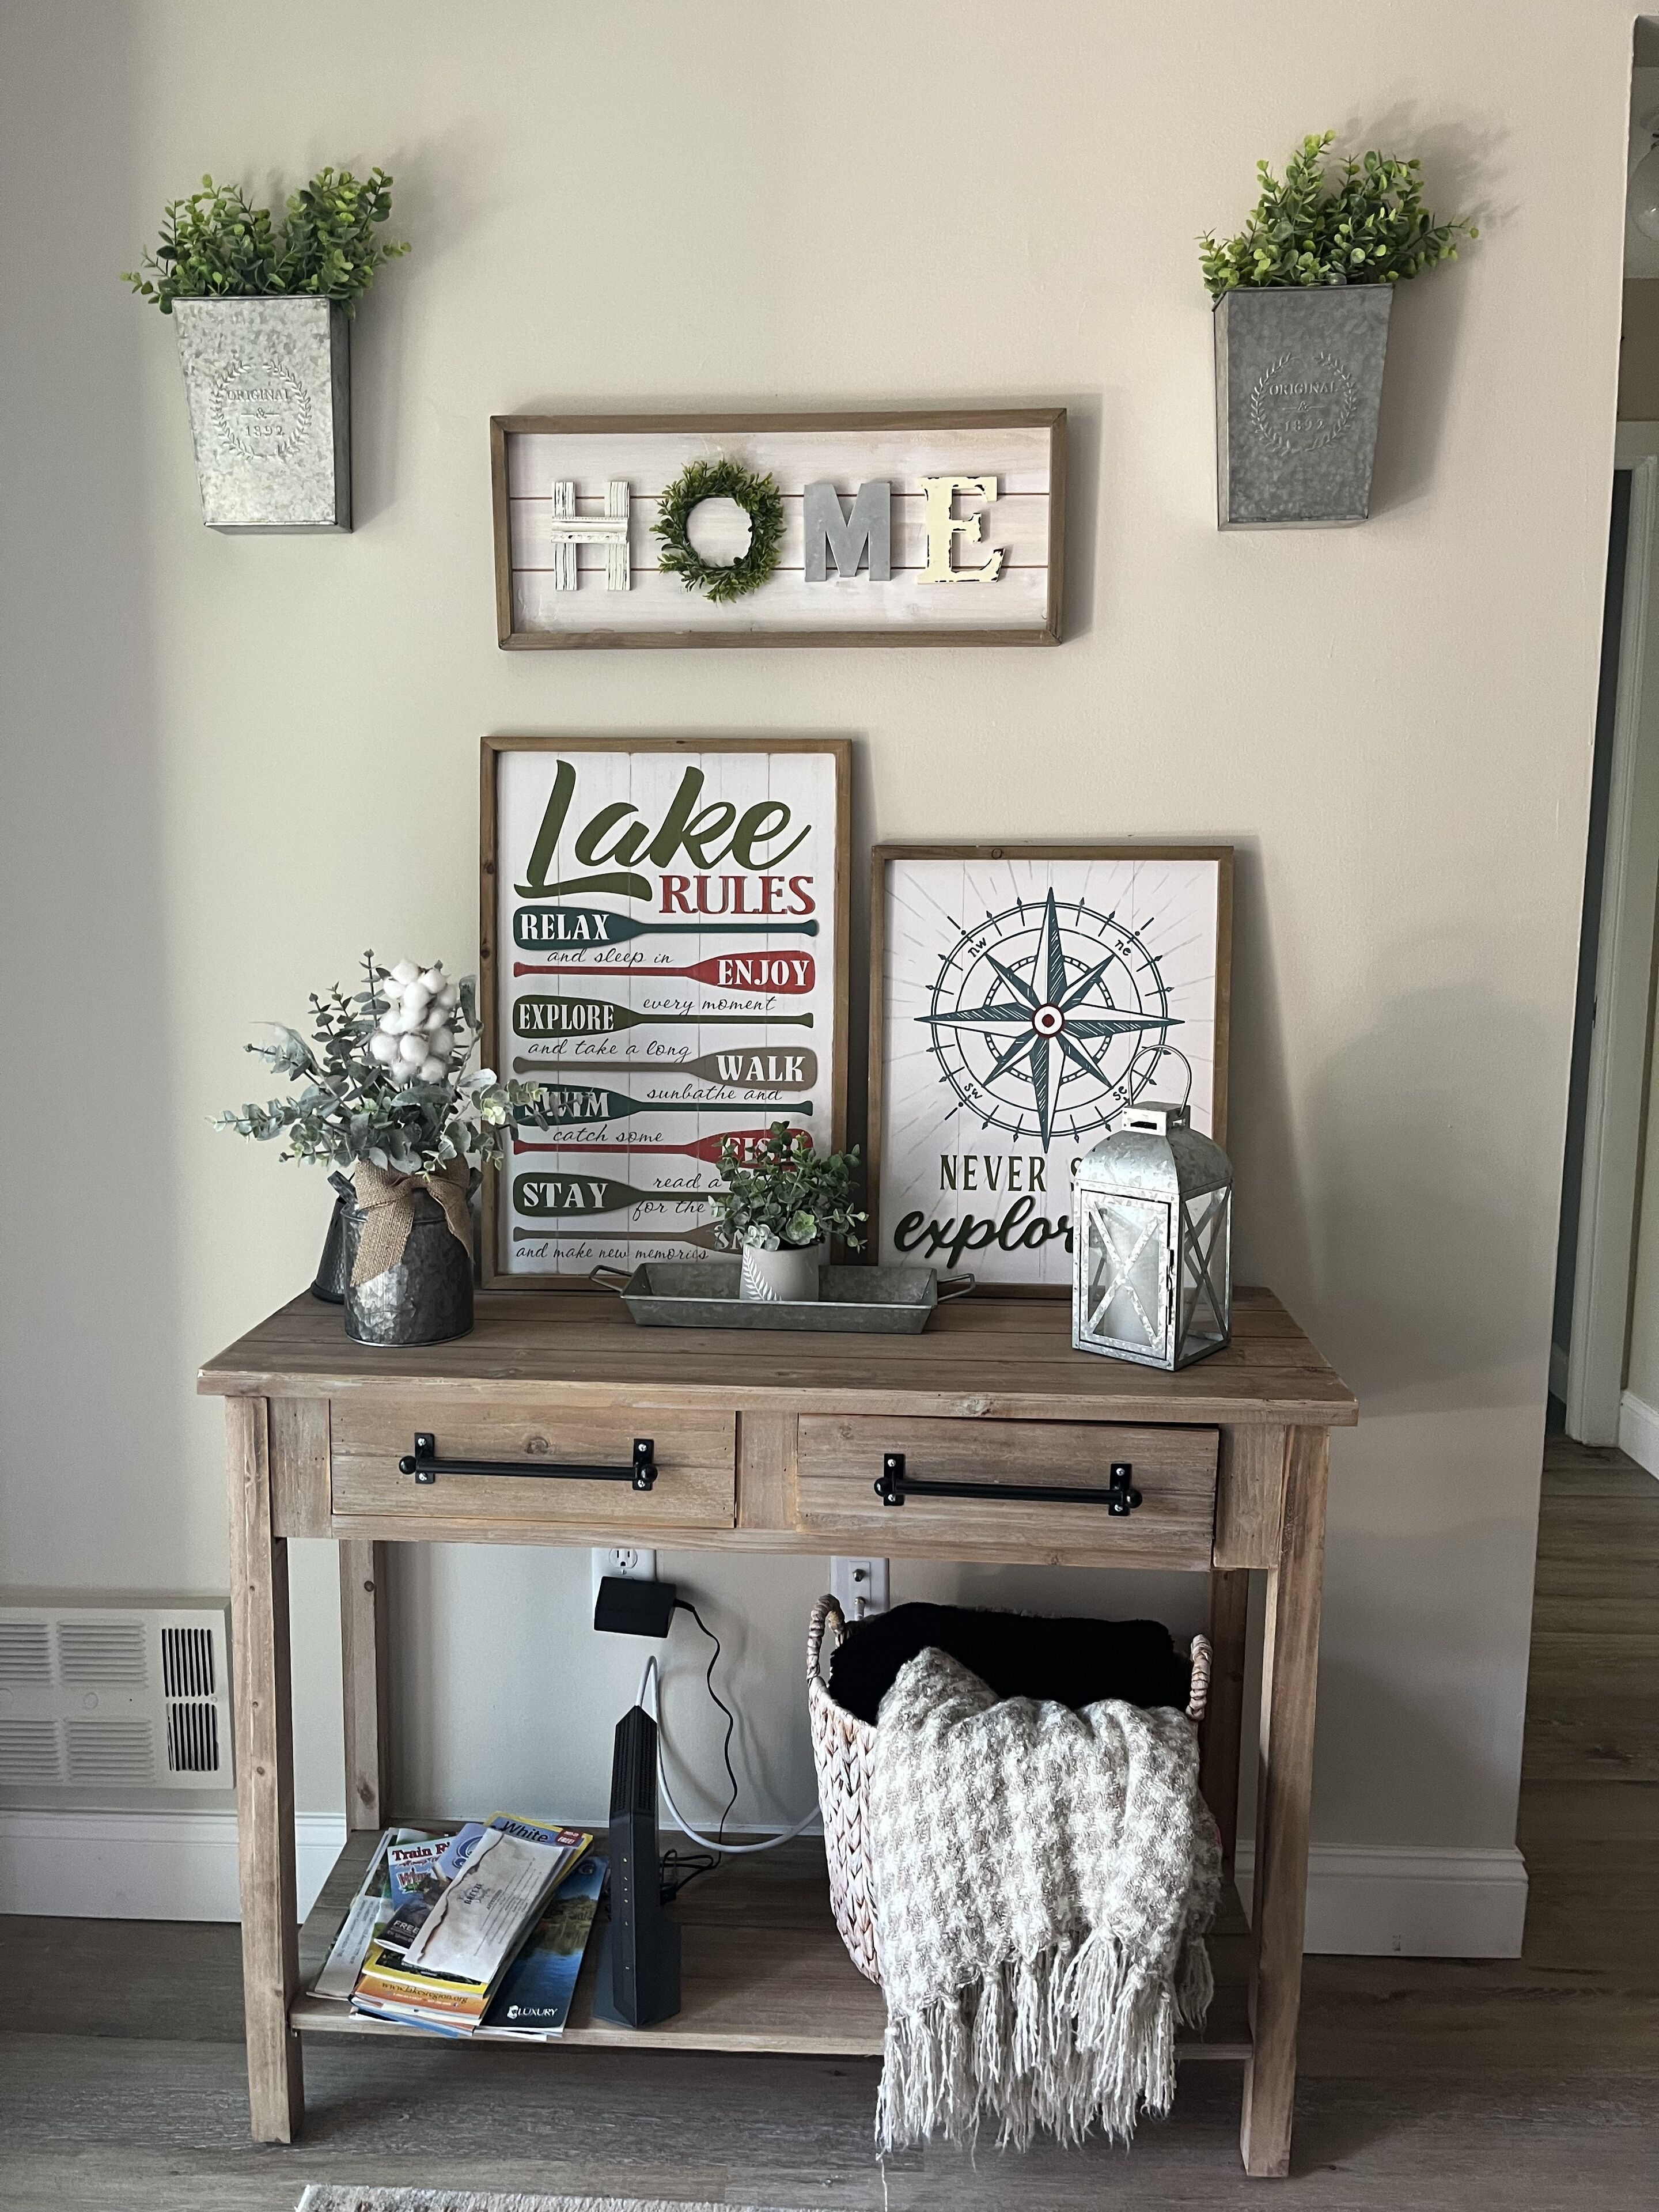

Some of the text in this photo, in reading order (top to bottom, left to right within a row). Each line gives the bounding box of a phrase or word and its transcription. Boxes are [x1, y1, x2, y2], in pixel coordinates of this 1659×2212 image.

[226, 389, 289, 403] ORIGINAL
[1269, 381, 1338, 396] ORIGINAL
[245, 425, 285, 438] 1892
[513, 759, 812, 902] Lake
[658, 874, 816, 915] RULES
[520, 914, 610, 941] RELAX
[1113, 938, 1132, 957] ne
[547, 948, 674, 968] and sleep in
[717, 959, 810, 987] ENJOY
[642, 995, 777, 1016] every moment
[518, 1003, 615, 1031] EXPLORE
[528, 1039, 692, 1064] and take a long
[715, 1055, 806, 1082] WALK
[646, 1084, 783, 1101] sunbathe and
[1112, 1085, 1127, 1101] se
[552, 1124, 664, 1143] catch some
[652, 1173, 722, 1189] read a
[940, 1154, 1047, 1192] NEVER
[522, 1183, 608, 1209] STAY
[632, 1200, 706, 1222] for the
[515, 1241, 710, 1260] and make new memories
[500, 1821, 548, 1842] White
[392, 1846, 433, 1861] Train
[518, 2008, 558, 2016] LUXURY
